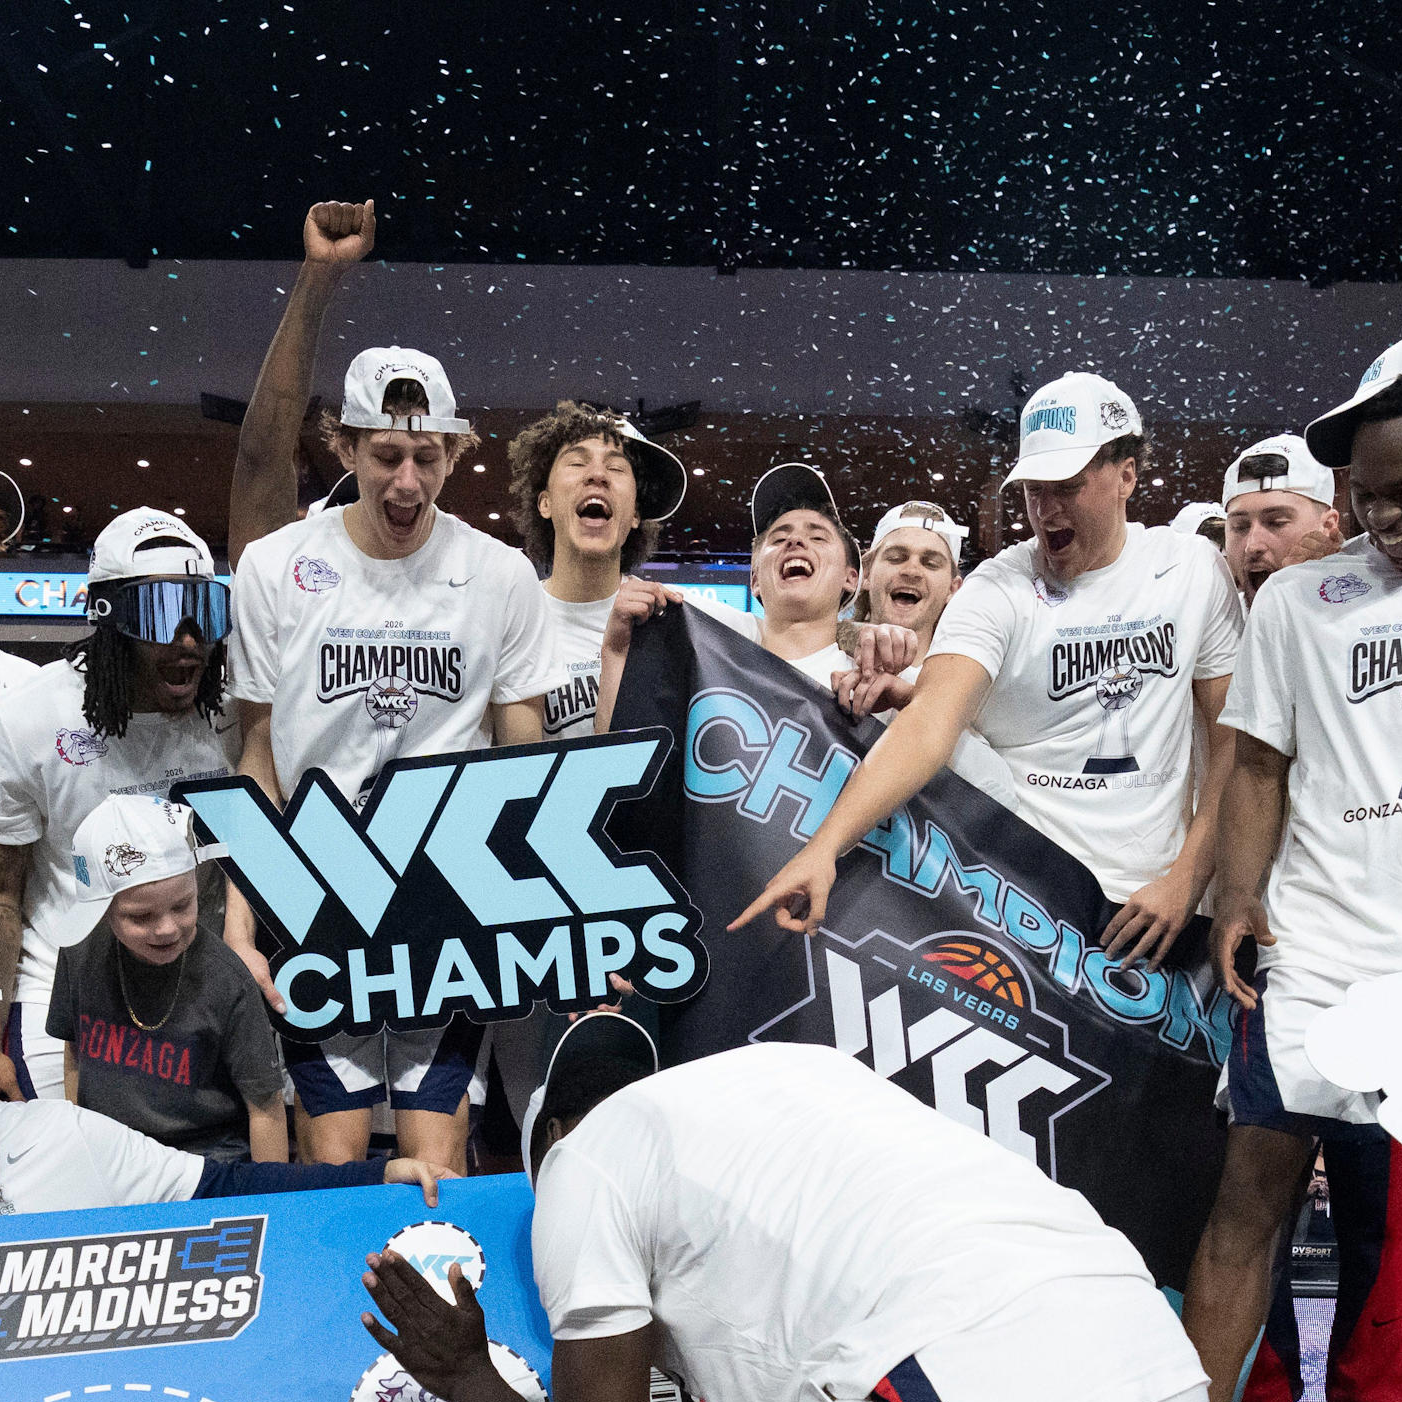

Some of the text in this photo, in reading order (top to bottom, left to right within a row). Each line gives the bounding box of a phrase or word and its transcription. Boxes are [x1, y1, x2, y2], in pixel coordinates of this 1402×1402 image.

[326, 627, 451, 640] WEST COAST CONFERENCE
[1056, 627, 1082, 637] WEST
[1360, 624, 1392, 636] WEST
[321, 643, 462, 694] CHAMPIONS
[1052, 623, 1175, 692] CHAMPIONS
[374, 694, 410, 708] WCC
[1104, 678, 1137, 697] WCC
[138, 779, 170, 794] COAST
[164, 767, 184, 778] 2026
[1027, 773, 1108, 790] GONZAGA
[183, 739, 677, 945] WCC
[684, 687, 1238, 1067] CHAMPION
[275, 912, 696, 1030] CHAMPS
[907, 965, 1020, 1031] LAS VEGAS
[825, 948, 1081, 1166] WCC
[17, 1275, 257, 1339] MADNESS
